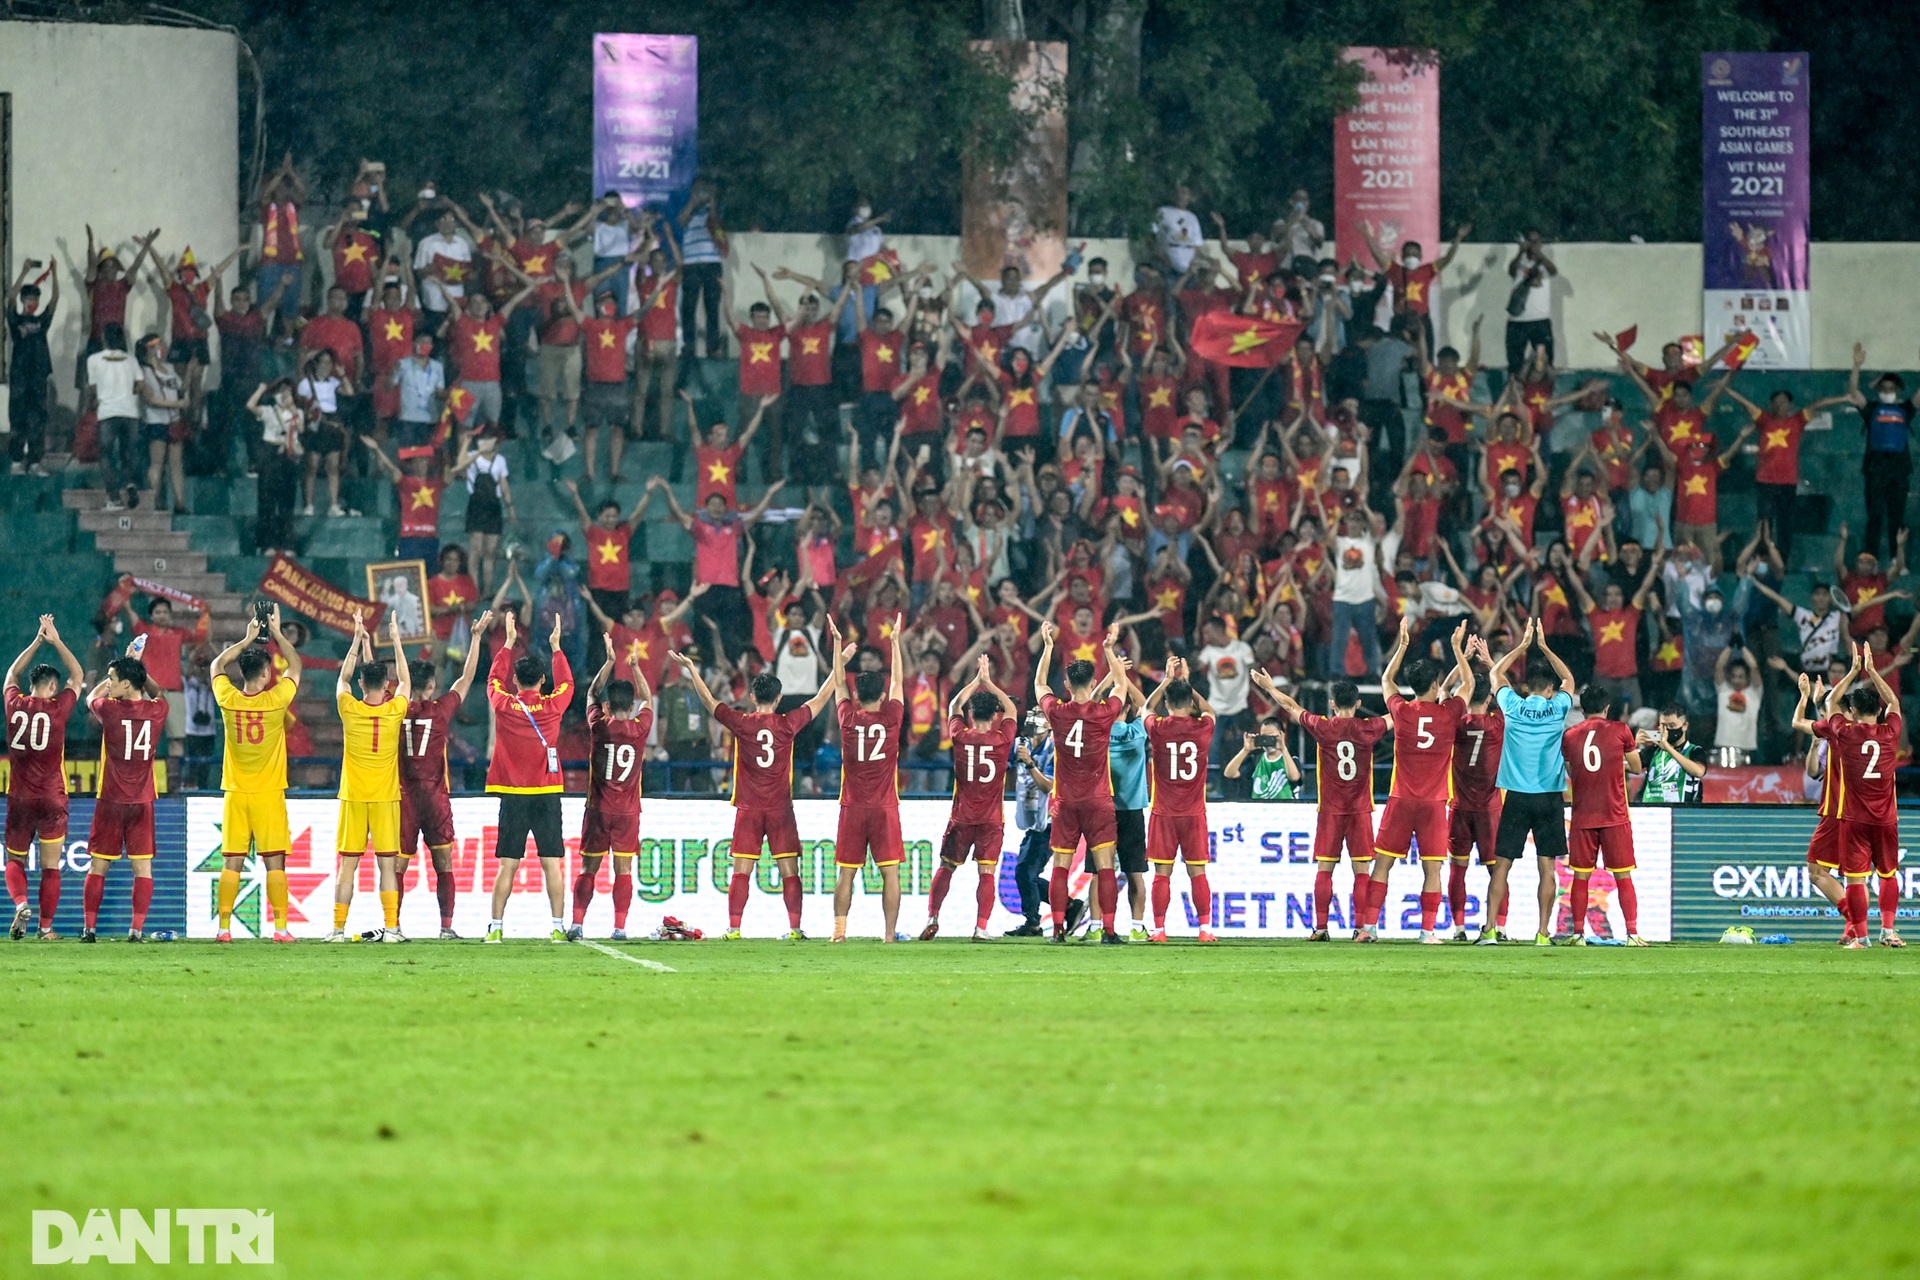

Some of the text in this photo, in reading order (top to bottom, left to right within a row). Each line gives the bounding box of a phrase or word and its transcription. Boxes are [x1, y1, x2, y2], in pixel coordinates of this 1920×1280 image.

[1717, 90, 1794, 103] WELCOME TO
[1732, 107, 1779, 121] THE 31st
[1717, 141, 1794, 154] ASIAN GAMES
[1719, 125, 1792, 138] SOUTHEAST
[617, 160, 671, 179] 2021
[1361, 169, 1415, 189] 2021
[1726, 161, 1786, 174] VIET NAM
[1730, 176, 1785, 196] 2021
[511, 702, 544, 713] VIENAM
[1519, 705, 1555, 719] VIETNAM
[10, 711, 51, 751] 20
[121, 719, 152, 761] 14
[235, 711, 265, 745] 18
[368, 716, 380, 753] 1
[402, 718, 433, 757] 17
[854, 723, 887, 762] 12
[1064, 719, 1084, 758] 4
[1416, 716, 1436, 749] 5
[604, 743, 636, 782] 19
[755, 729, 775, 769] 3
[964, 744, 997, 784] 15
[1166, 742, 1198, 781] 13
[1336, 741, 1357, 781] 8
[1466, 730, 1485, 767] 7
[1583, 730, 1602, 772] 6
[1861, 740, 1882, 779] 2
[1181, 891, 1276, 929] VIET
[1400, 893, 1488, 930] 202
